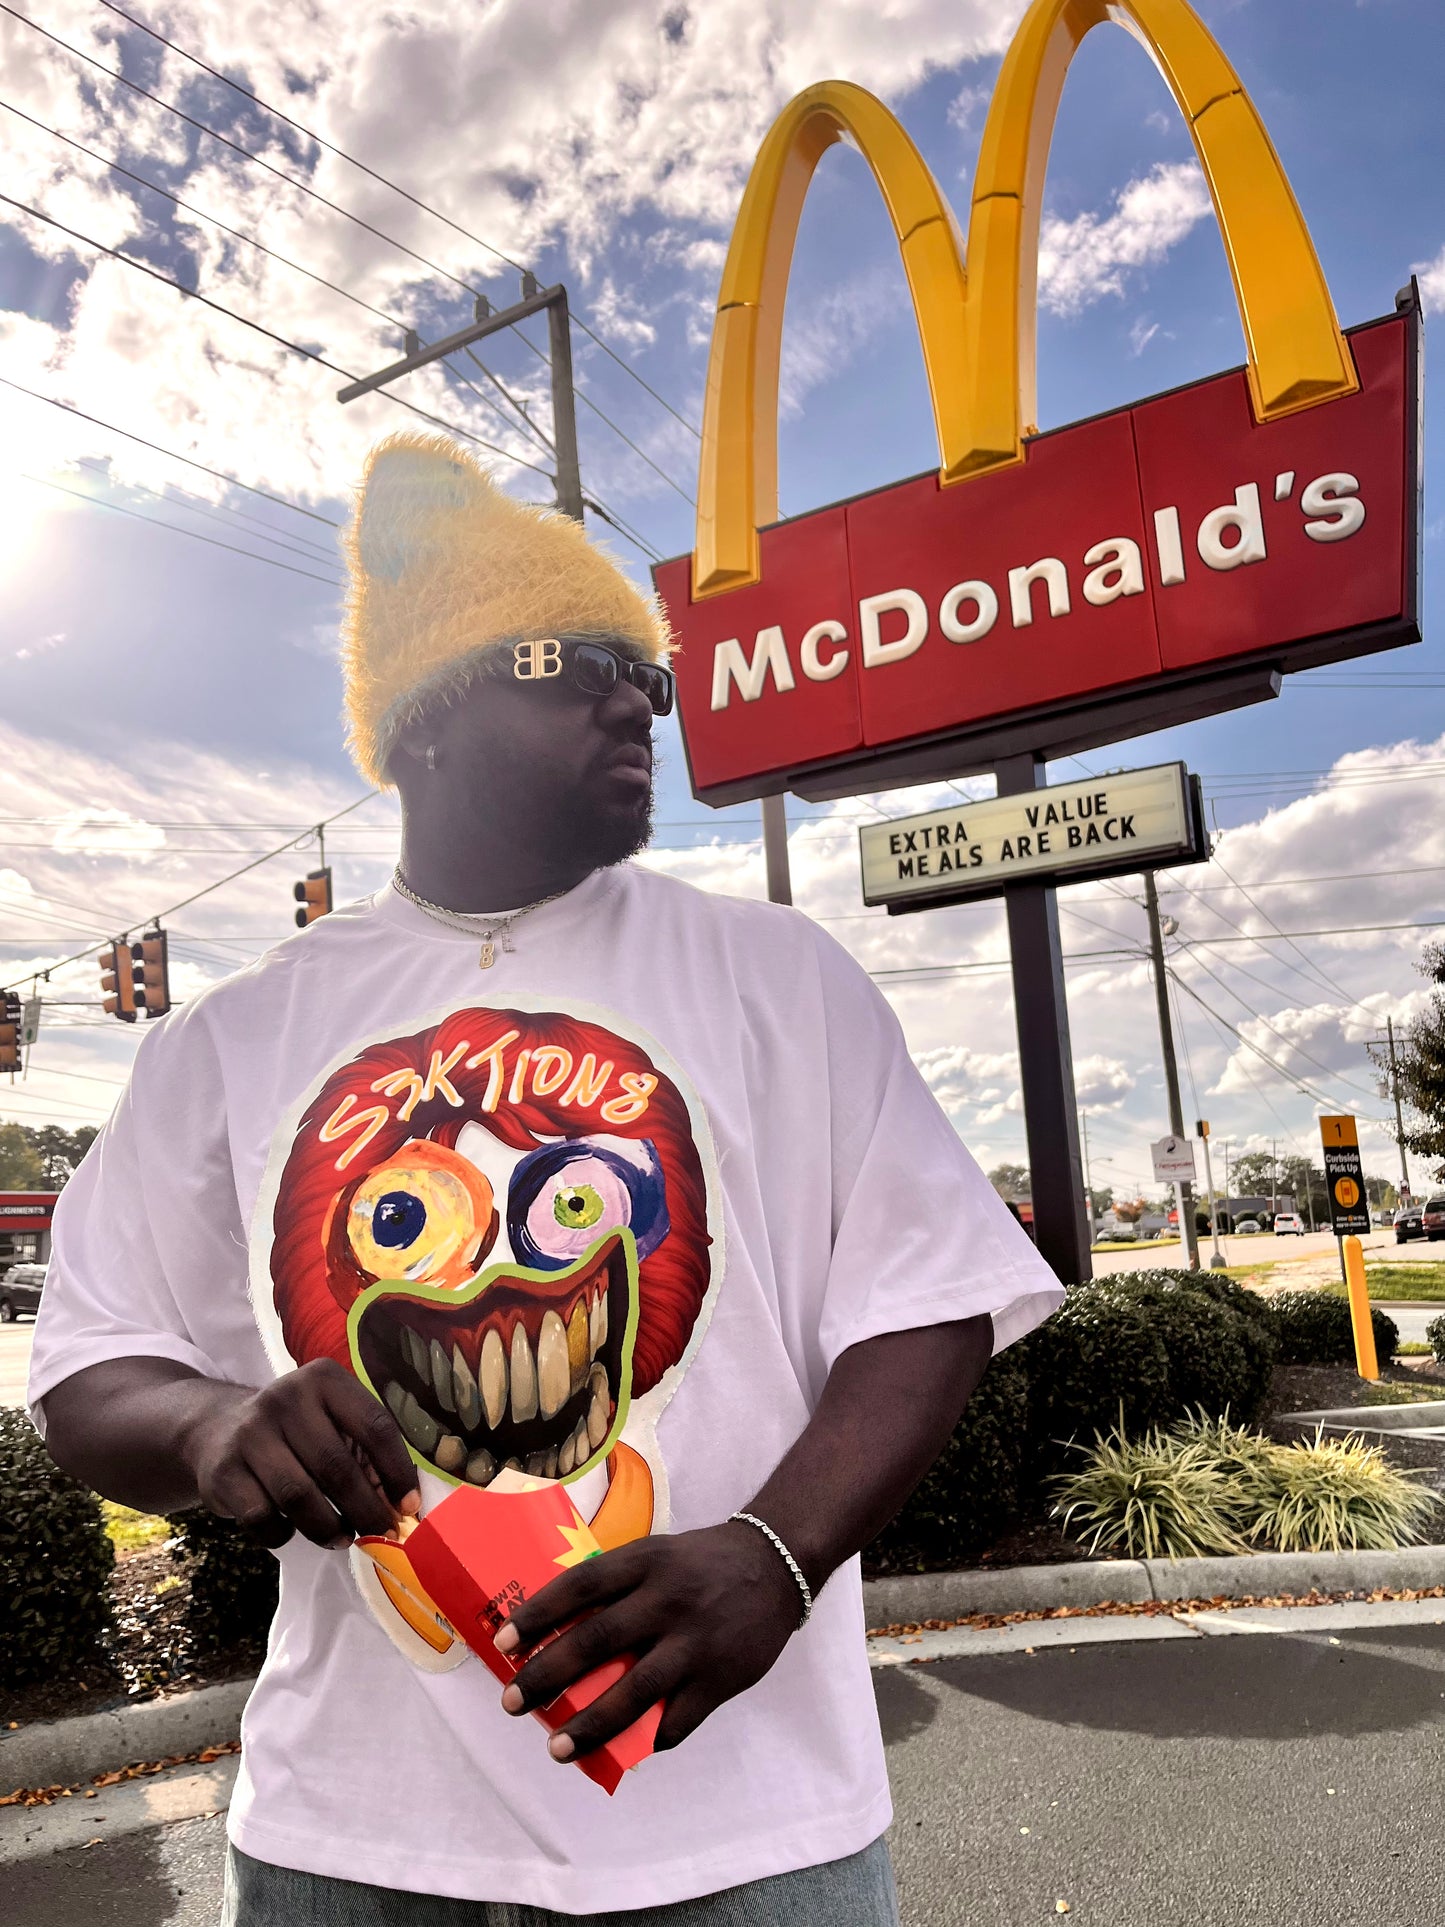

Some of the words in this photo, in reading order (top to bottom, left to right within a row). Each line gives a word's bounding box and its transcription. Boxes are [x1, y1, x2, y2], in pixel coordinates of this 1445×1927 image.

[710, 469, 1367, 712] McDonald's
[889, 821, 968, 855] EXTRA
[1025, 793, 1108, 828] VALUE
[898, 844, 983, 880] MEALS
[1000, 831, 1051, 862] ARE
[1067, 815, 1136, 849] BACK
[1334, 1122, 1342, 1139] 1
[1325, 1152, 1359, 1164] Curbside
[1330, 1163, 1347, 1174] Pick
[1346, 1163, 1359, 1175] Up
[483, 1588, 508, 1618] HOW
[505, 1579, 521, 1595] TO
